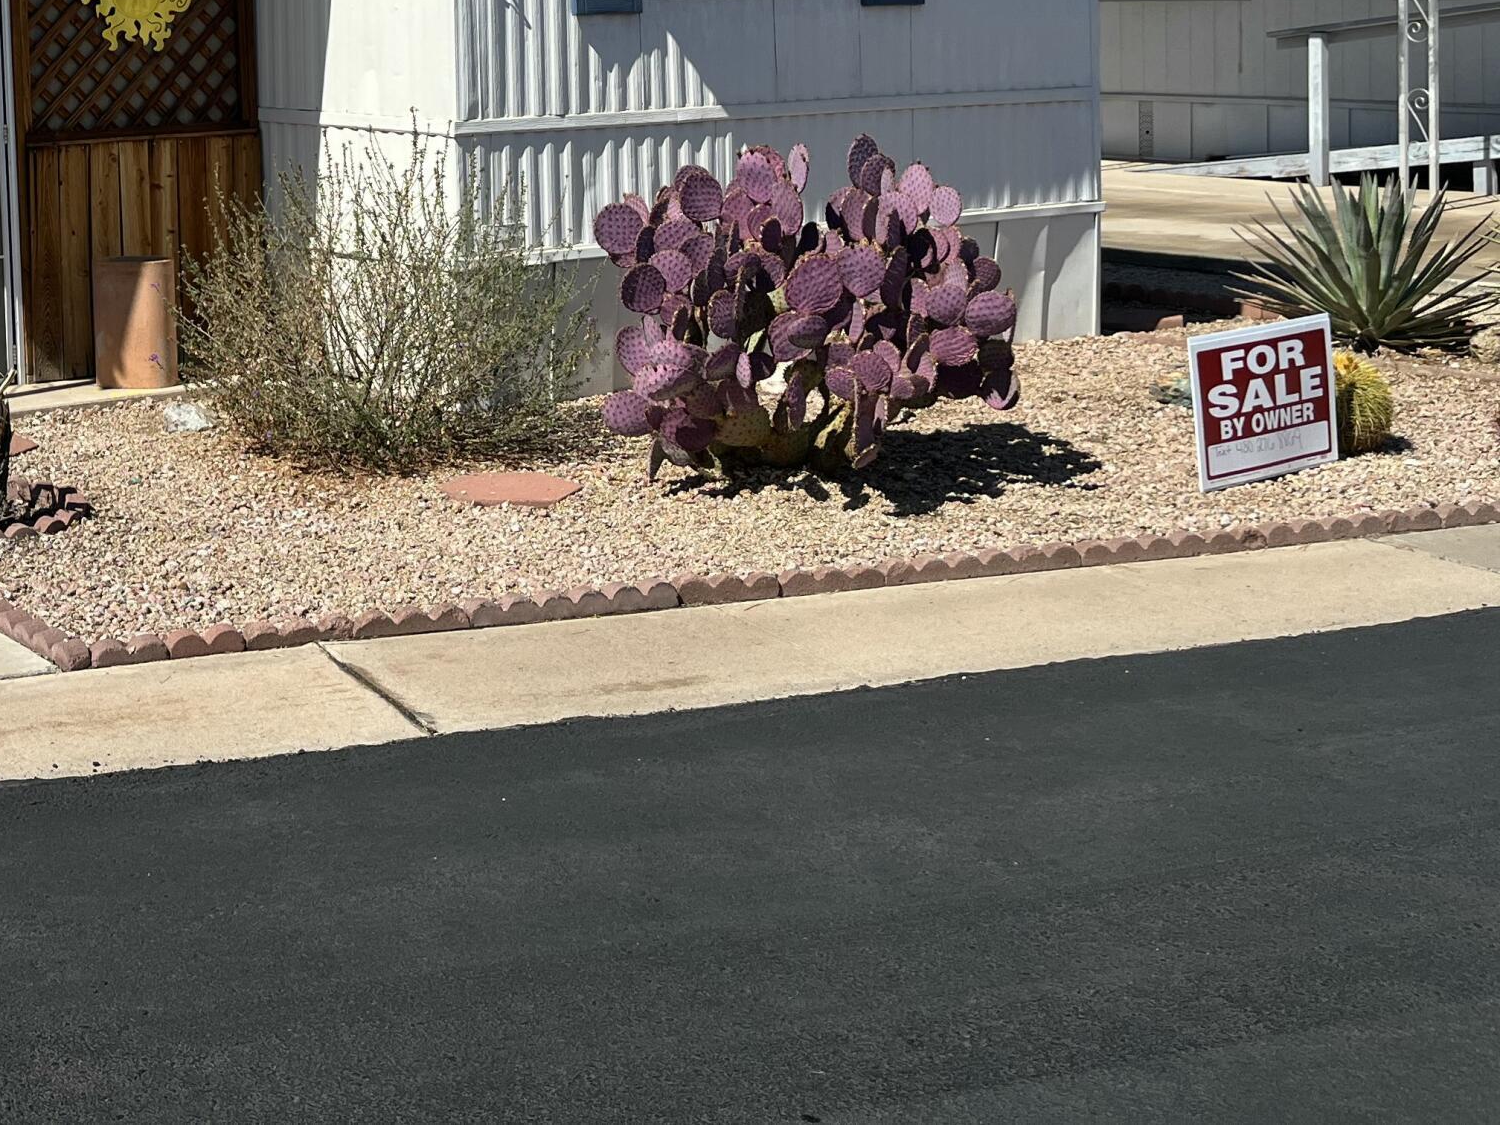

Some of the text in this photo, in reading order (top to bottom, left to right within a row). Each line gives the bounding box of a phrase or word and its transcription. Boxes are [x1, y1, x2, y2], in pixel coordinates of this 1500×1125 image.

[1220, 339, 1305, 381] FOR
[1207, 365, 1324, 419] SALE
[1220, 416, 1245, 440] BY
[1251, 402, 1315, 433] OWNER
